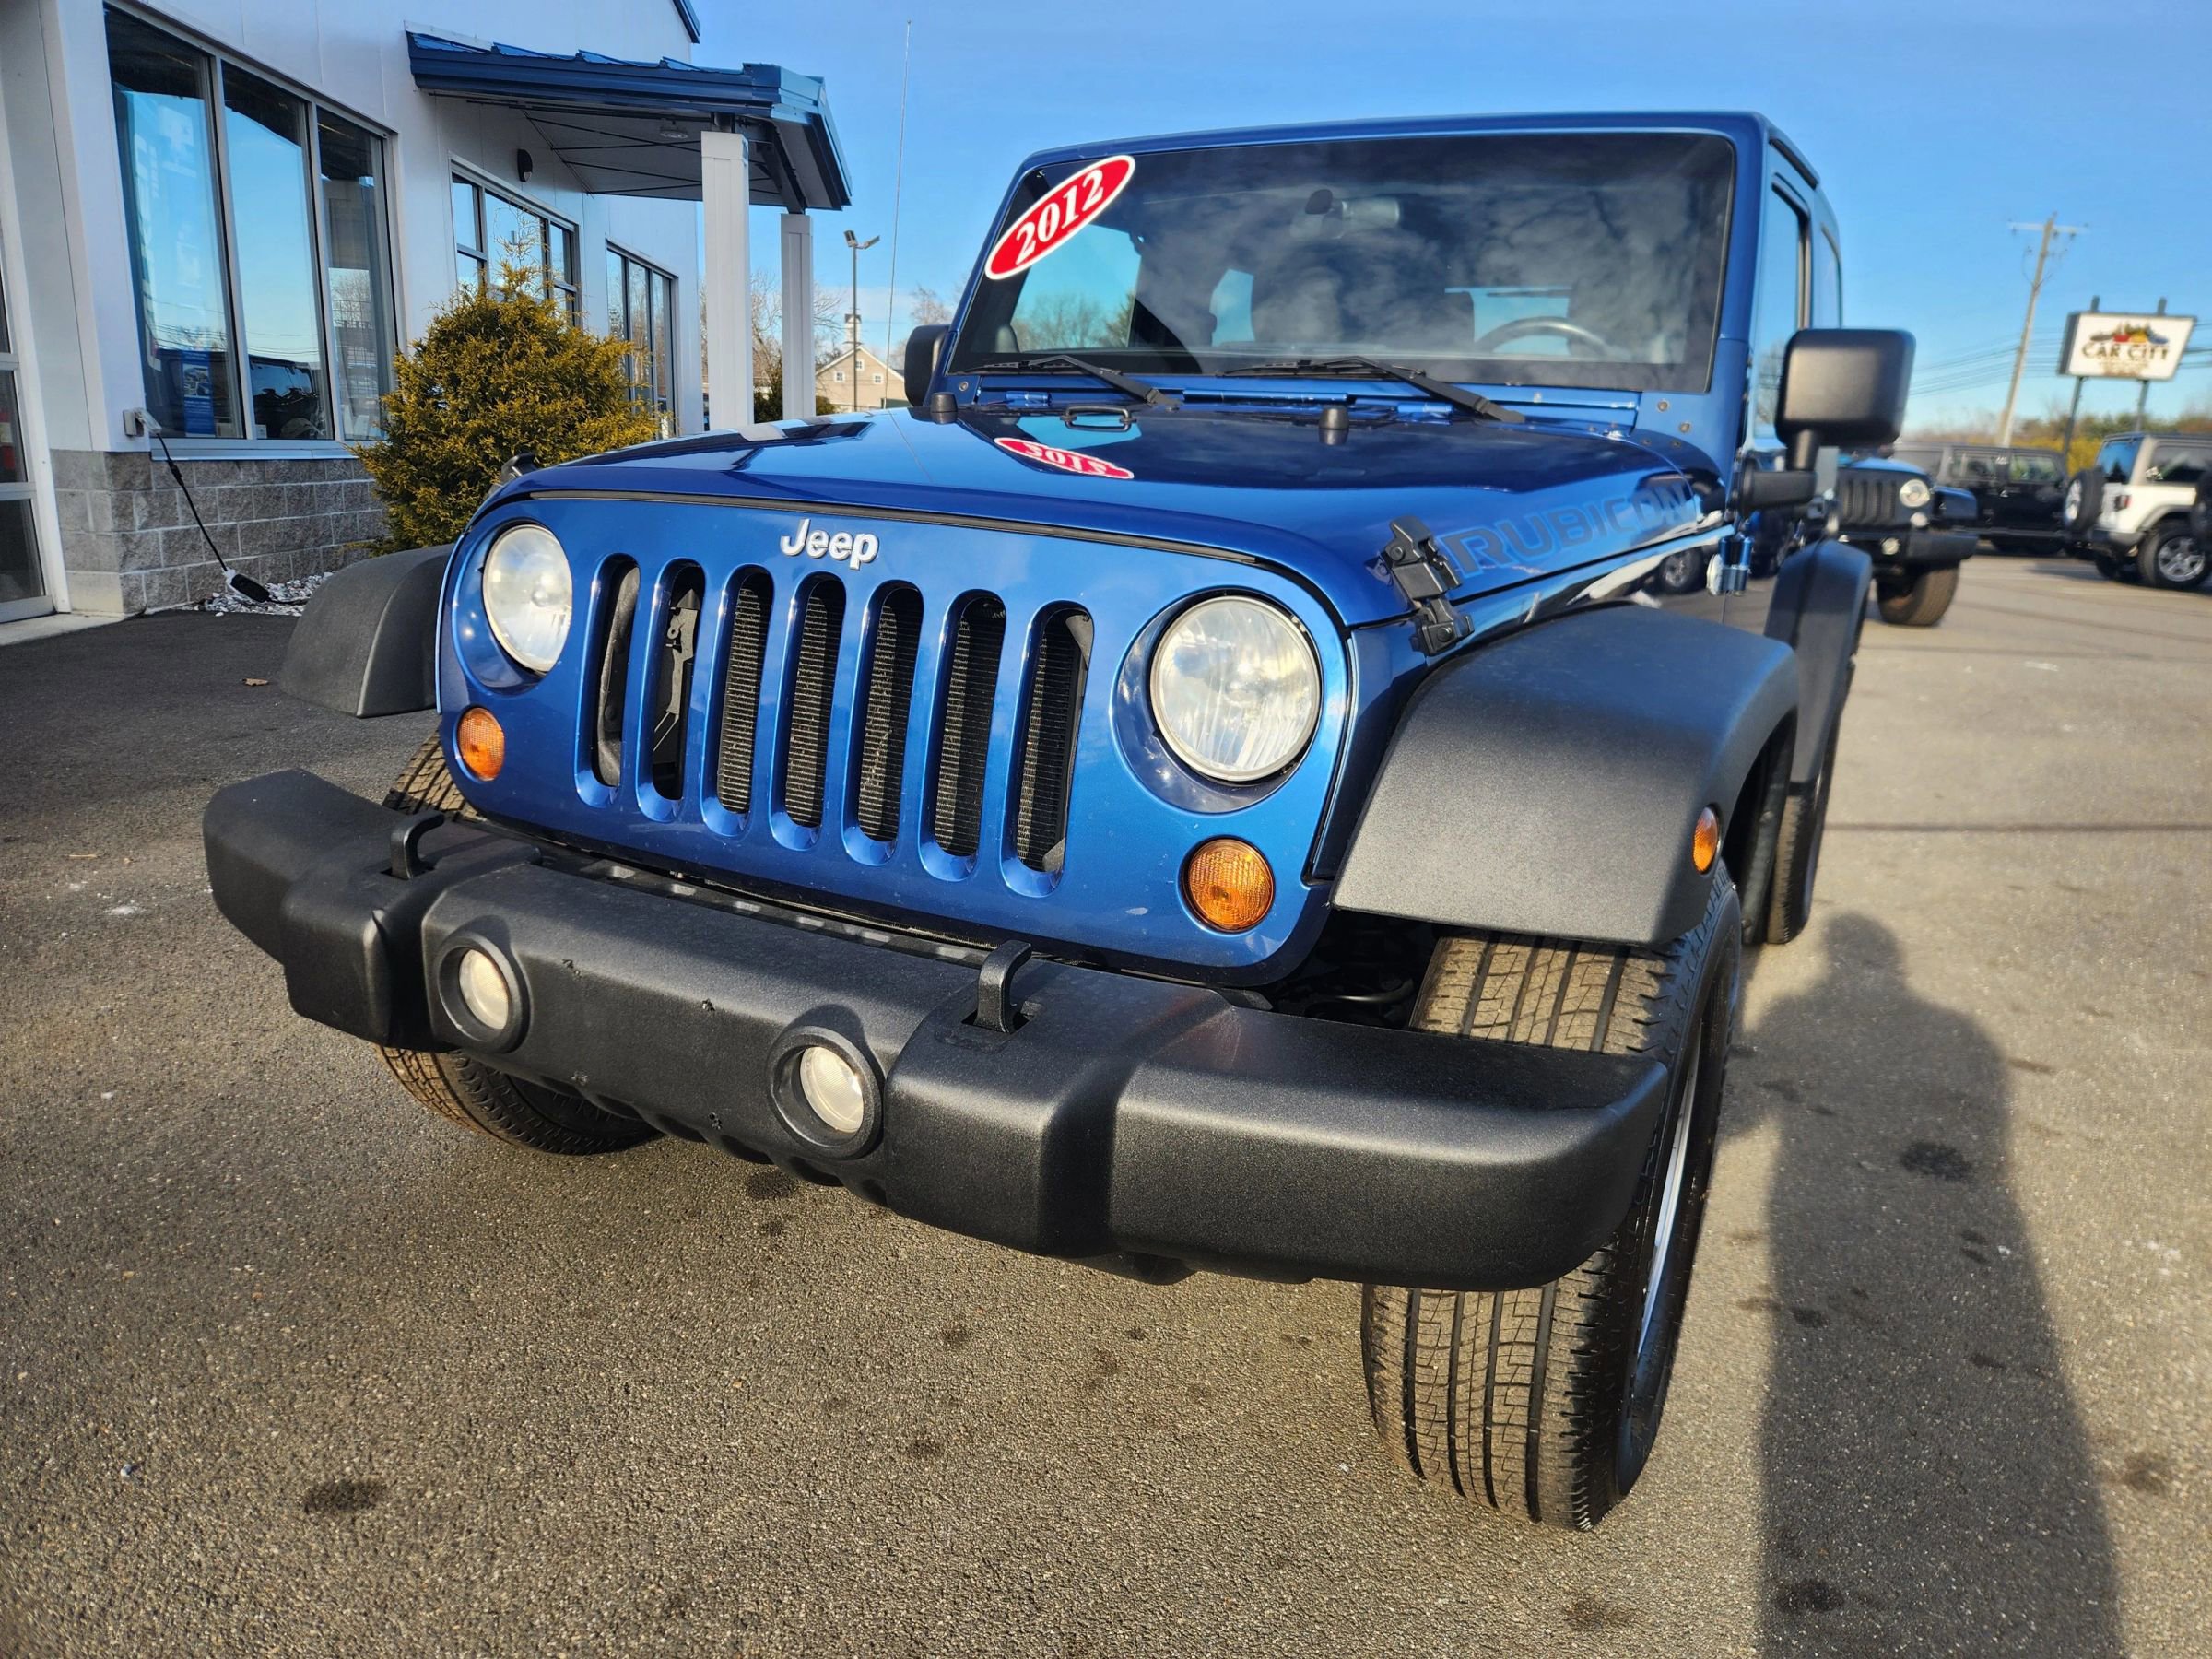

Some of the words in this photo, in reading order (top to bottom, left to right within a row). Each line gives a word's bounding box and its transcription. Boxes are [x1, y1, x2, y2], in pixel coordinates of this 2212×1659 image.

[1016, 170, 1104, 265] 2012
[780, 518, 878, 570] Jeep
[1439, 480, 1694, 578] RUBICON
